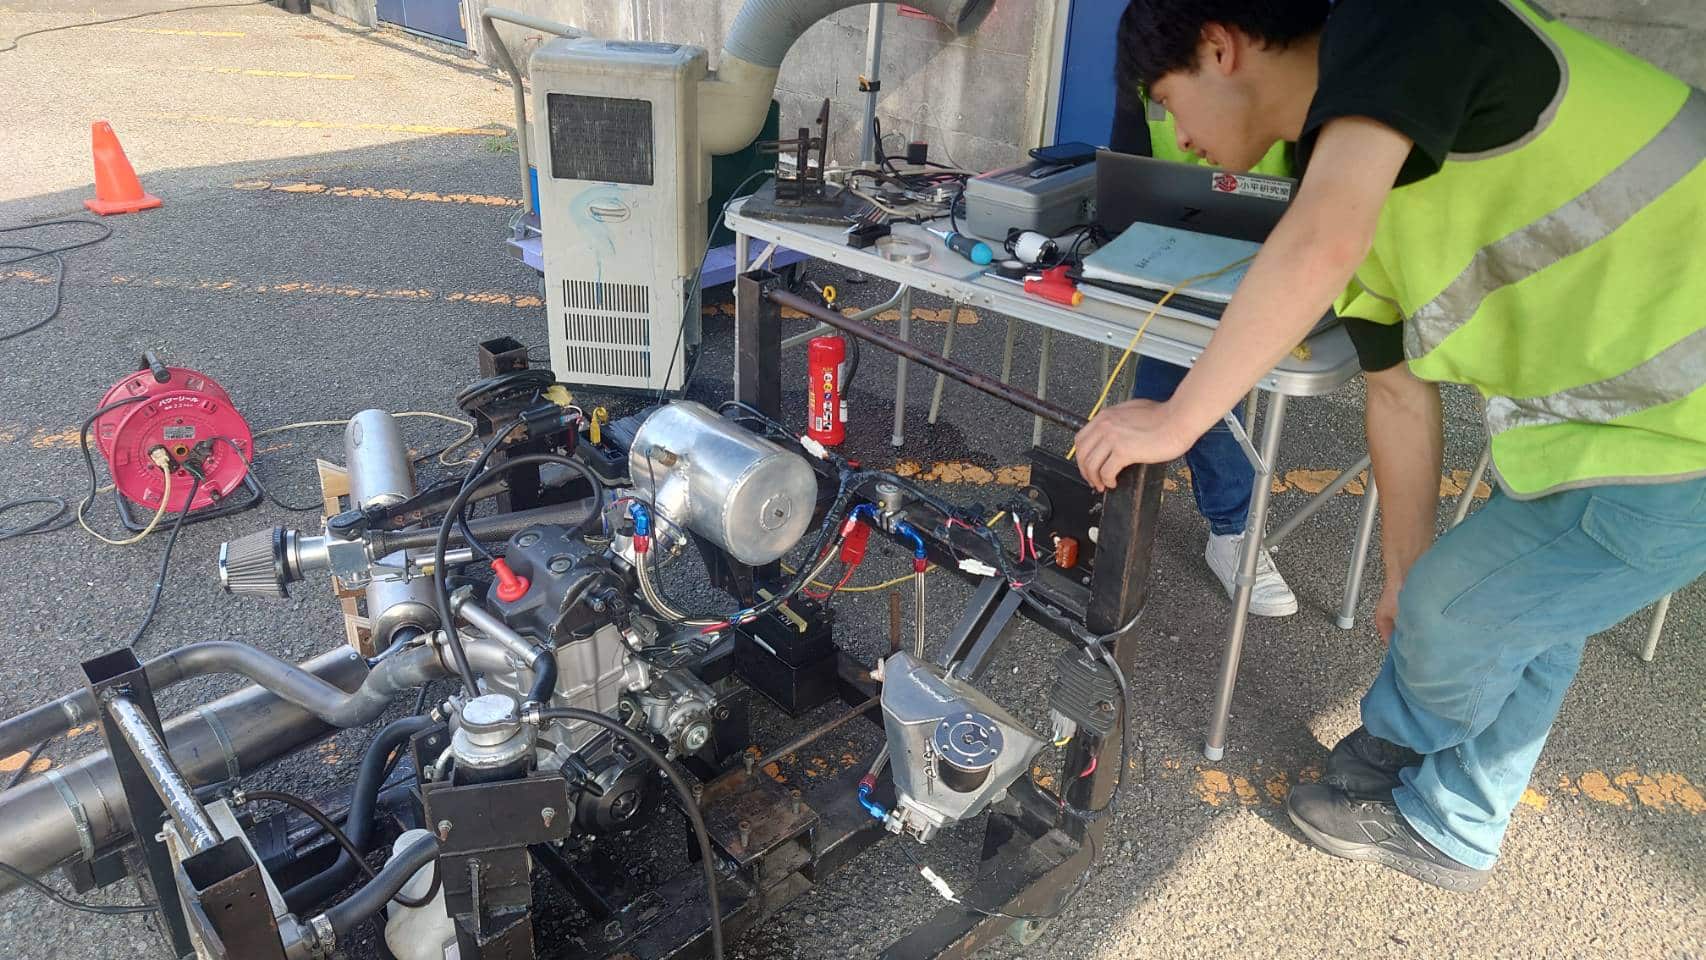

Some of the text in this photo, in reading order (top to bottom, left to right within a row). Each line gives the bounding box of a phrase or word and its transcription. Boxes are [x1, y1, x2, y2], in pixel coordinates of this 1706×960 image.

[1240, 182, 1288, 195] 小平研究室
